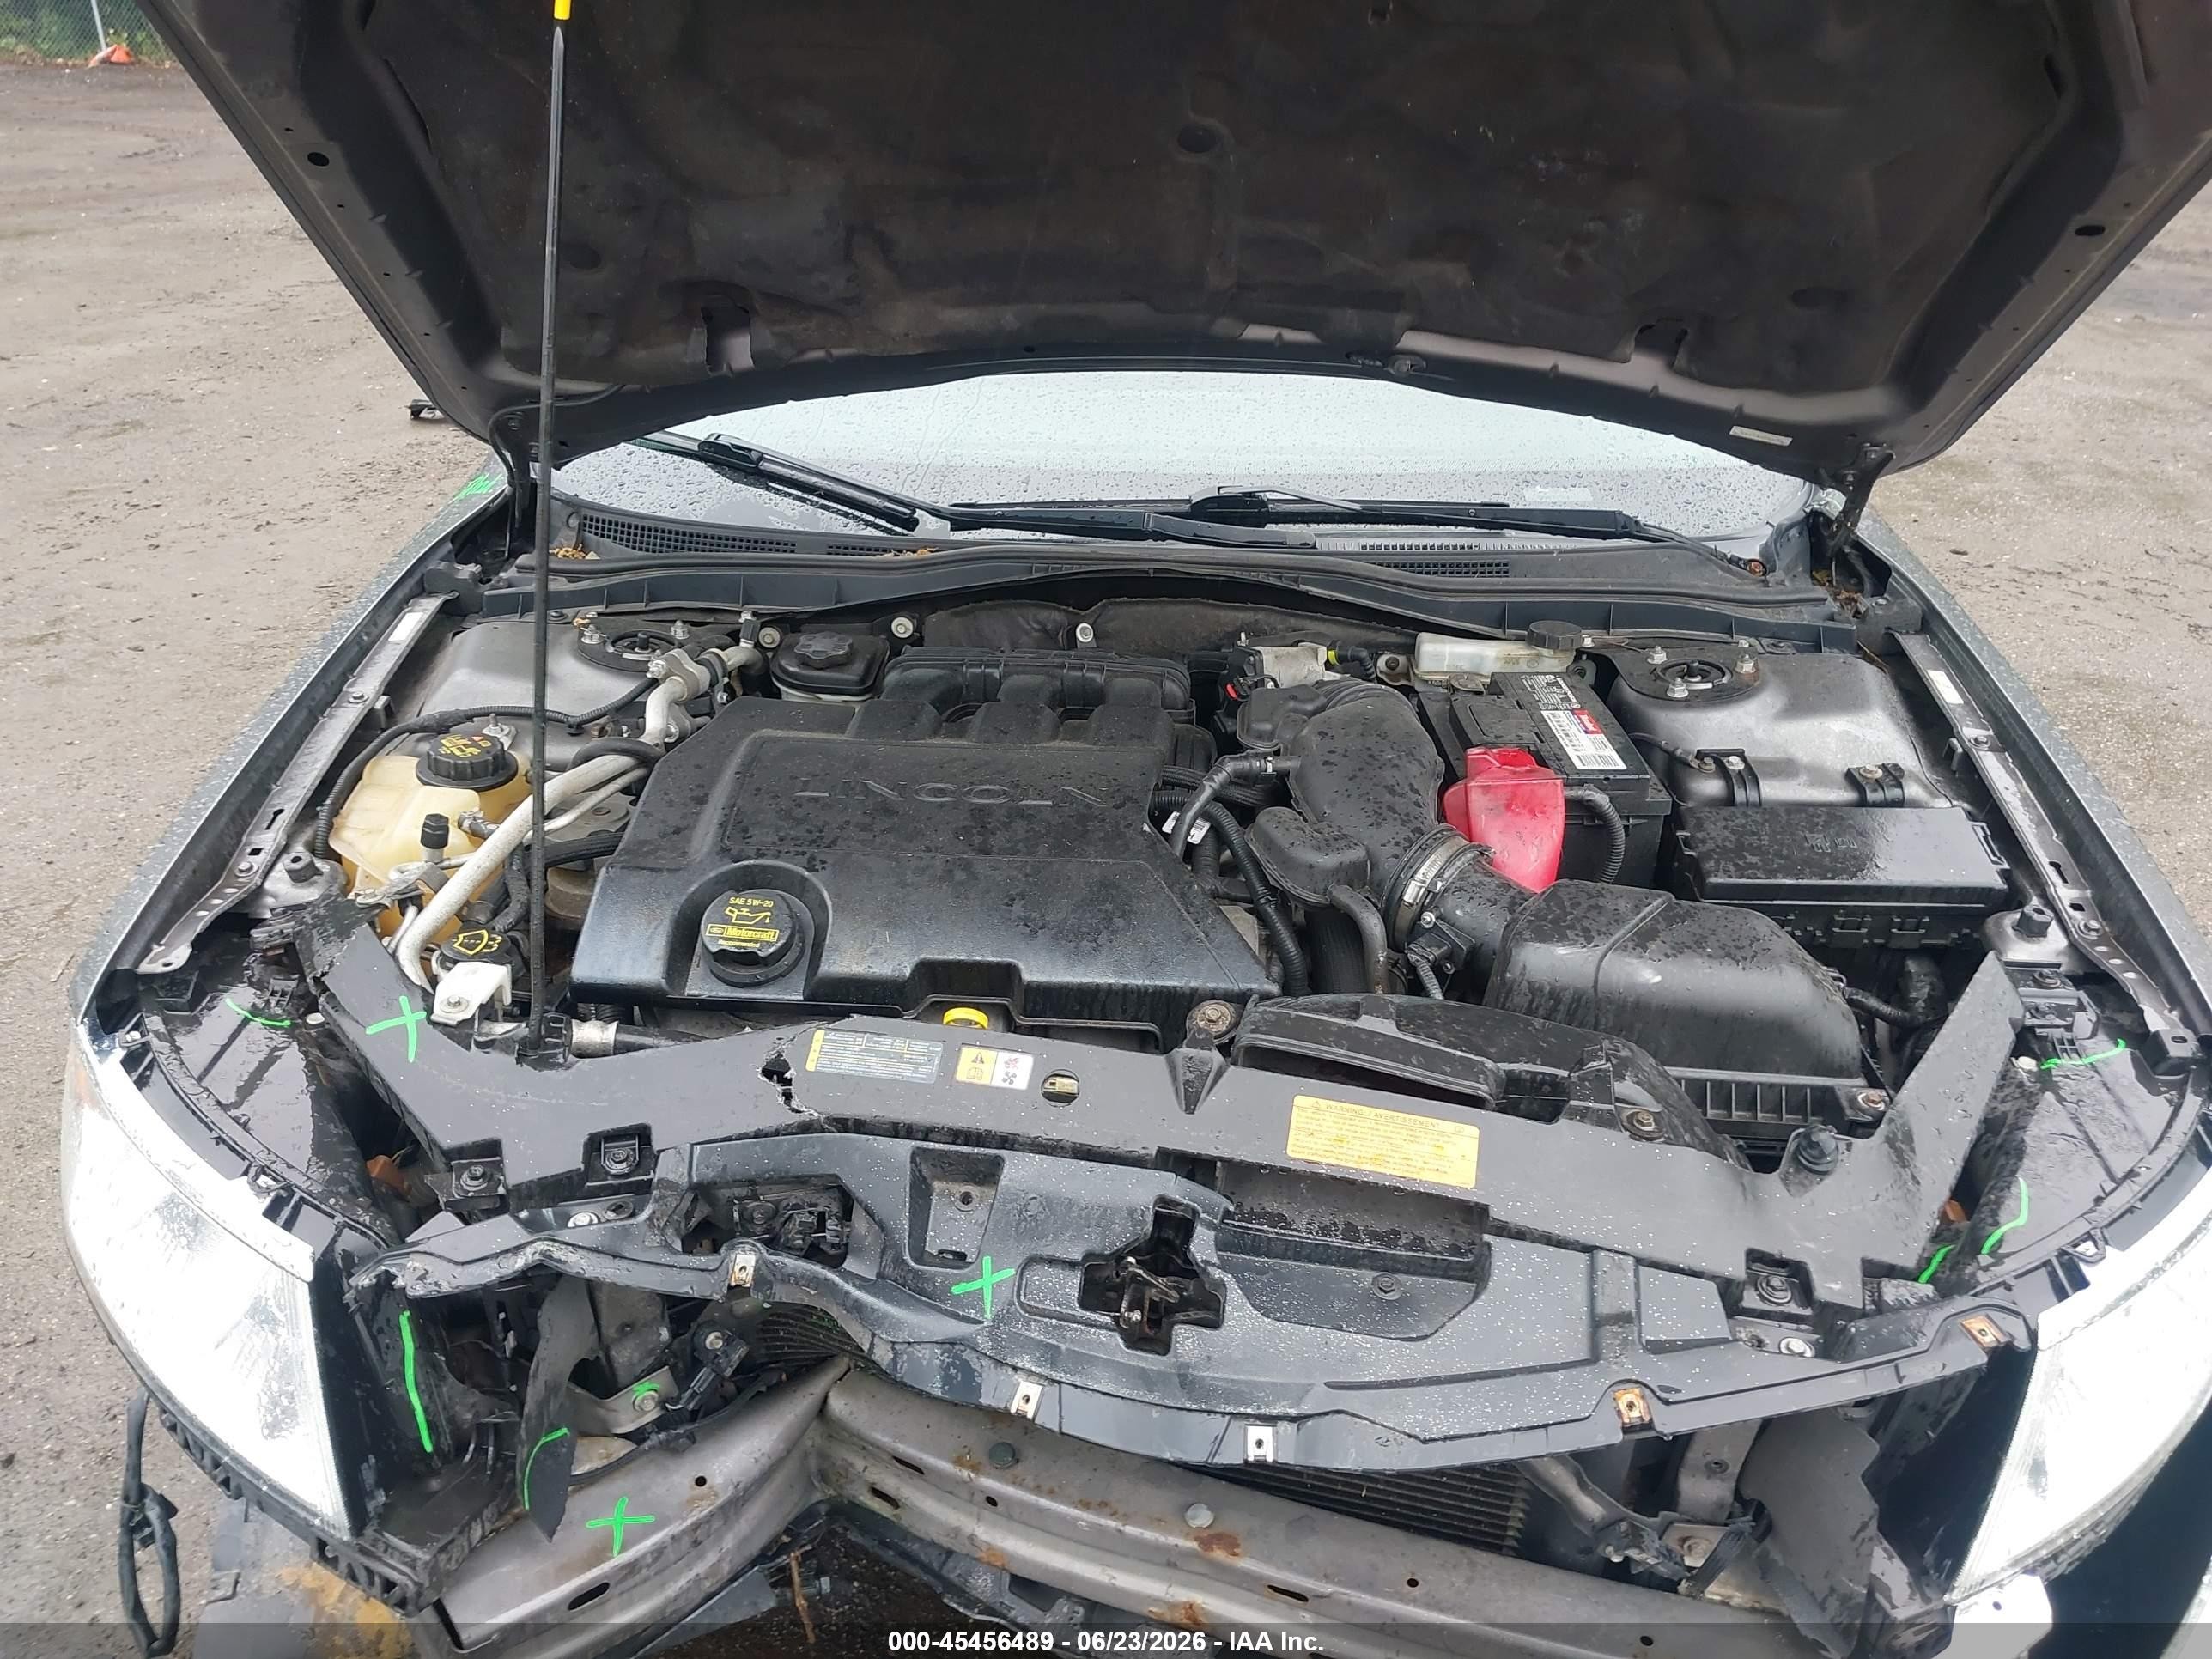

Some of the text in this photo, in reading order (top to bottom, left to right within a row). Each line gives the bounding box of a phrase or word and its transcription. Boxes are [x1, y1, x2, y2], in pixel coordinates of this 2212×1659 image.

[793, 777, 1111, 807] LINCOLN
[728, 896, 775, 908] SAE 5W-20
[726, 927, 775, 940] Motorcraft
[1326, 1103, 1364, 1115] WARNING
[1373, 1112, 1440, 1128] AVERTISSEMENT
